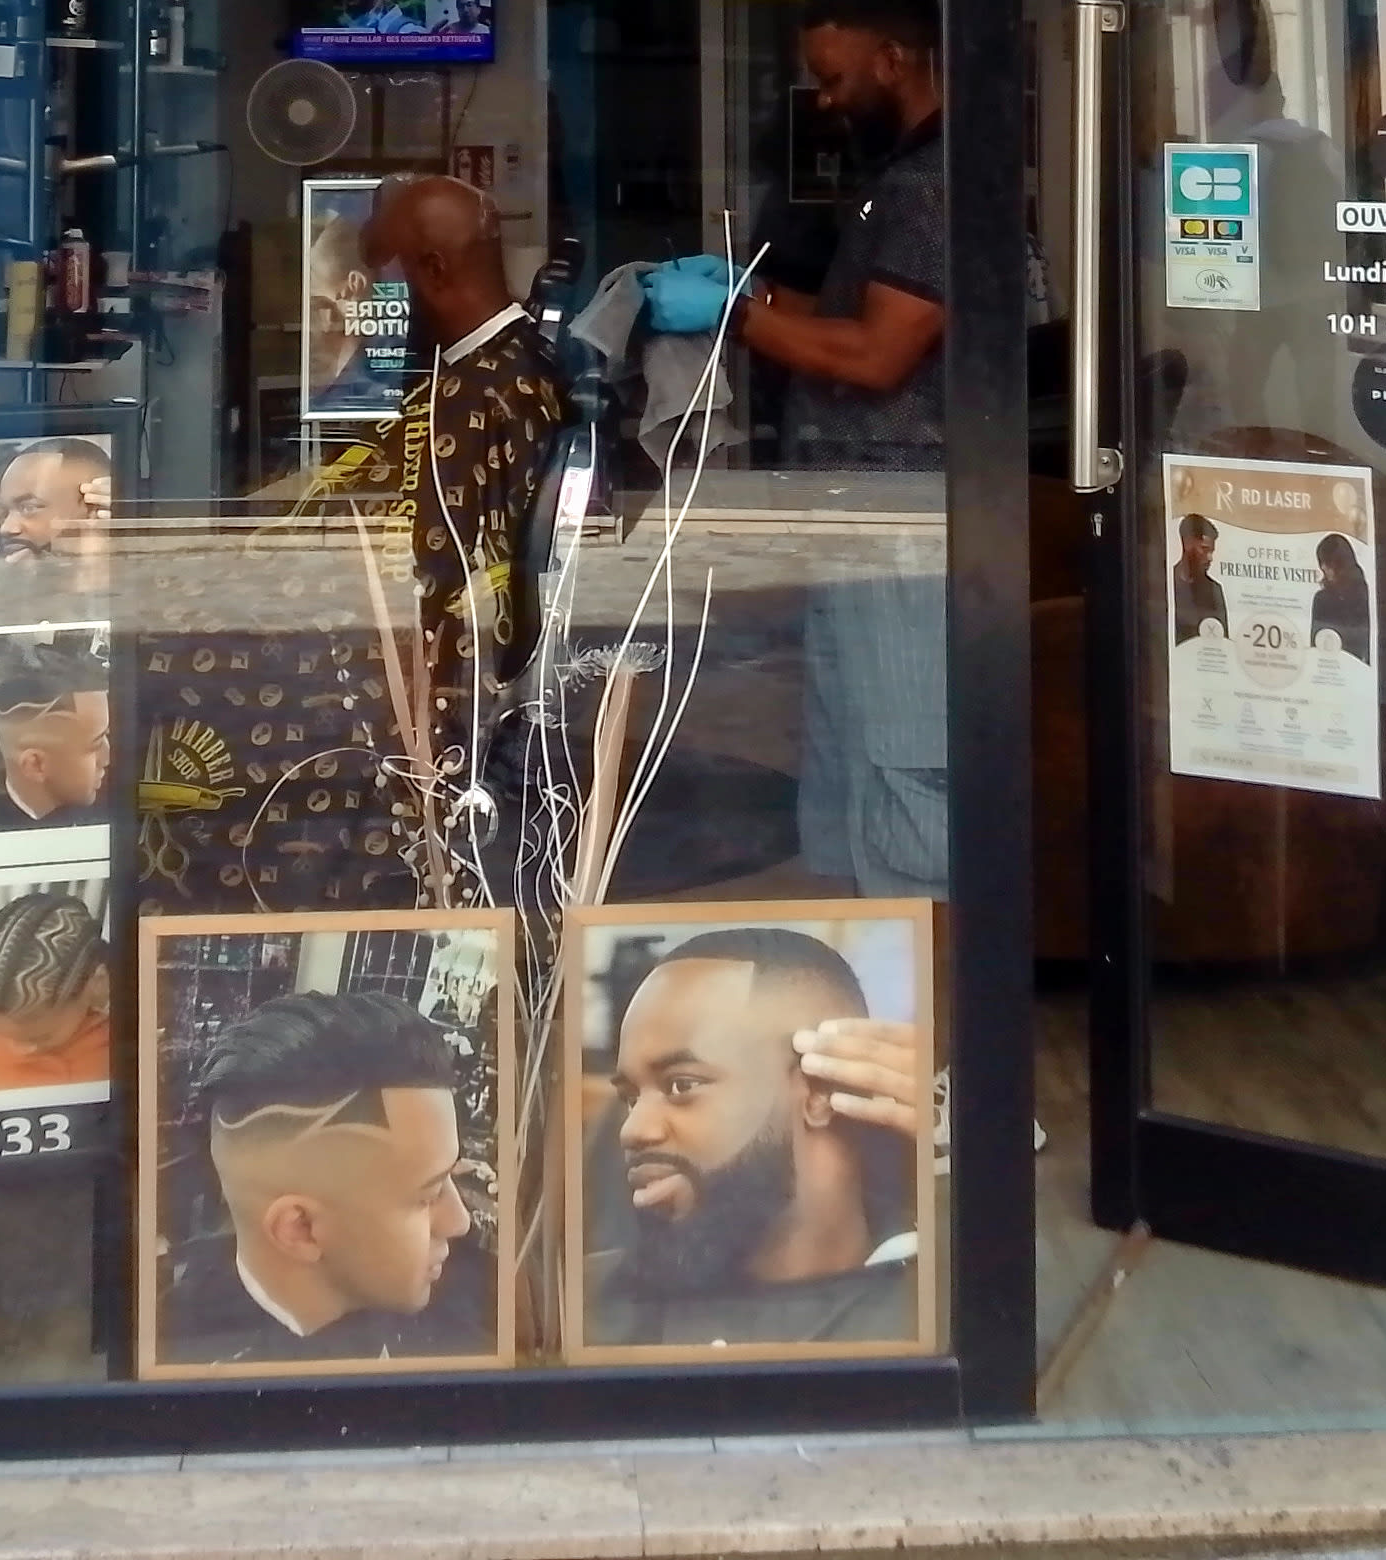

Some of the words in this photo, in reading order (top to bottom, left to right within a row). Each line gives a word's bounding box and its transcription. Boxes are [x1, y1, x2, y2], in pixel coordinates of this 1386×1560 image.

[1175, 246, 1196, 256] VISA
[1207, 247, 1228, 256] VISA
[1241, 488, 1261, 505] RD
[1265, 490, 1312, 511] LASER
[1247, 547, 1290, 562] OFFRE
[1219, 560, 1279, 581] PREMIÈRE
[1243, 623, 1298, 649] -20%
[170, 716, 235, 785] BARBER
[167, 747, 202, 781] SHOP
[0, 1113, 73, 1159] 33
